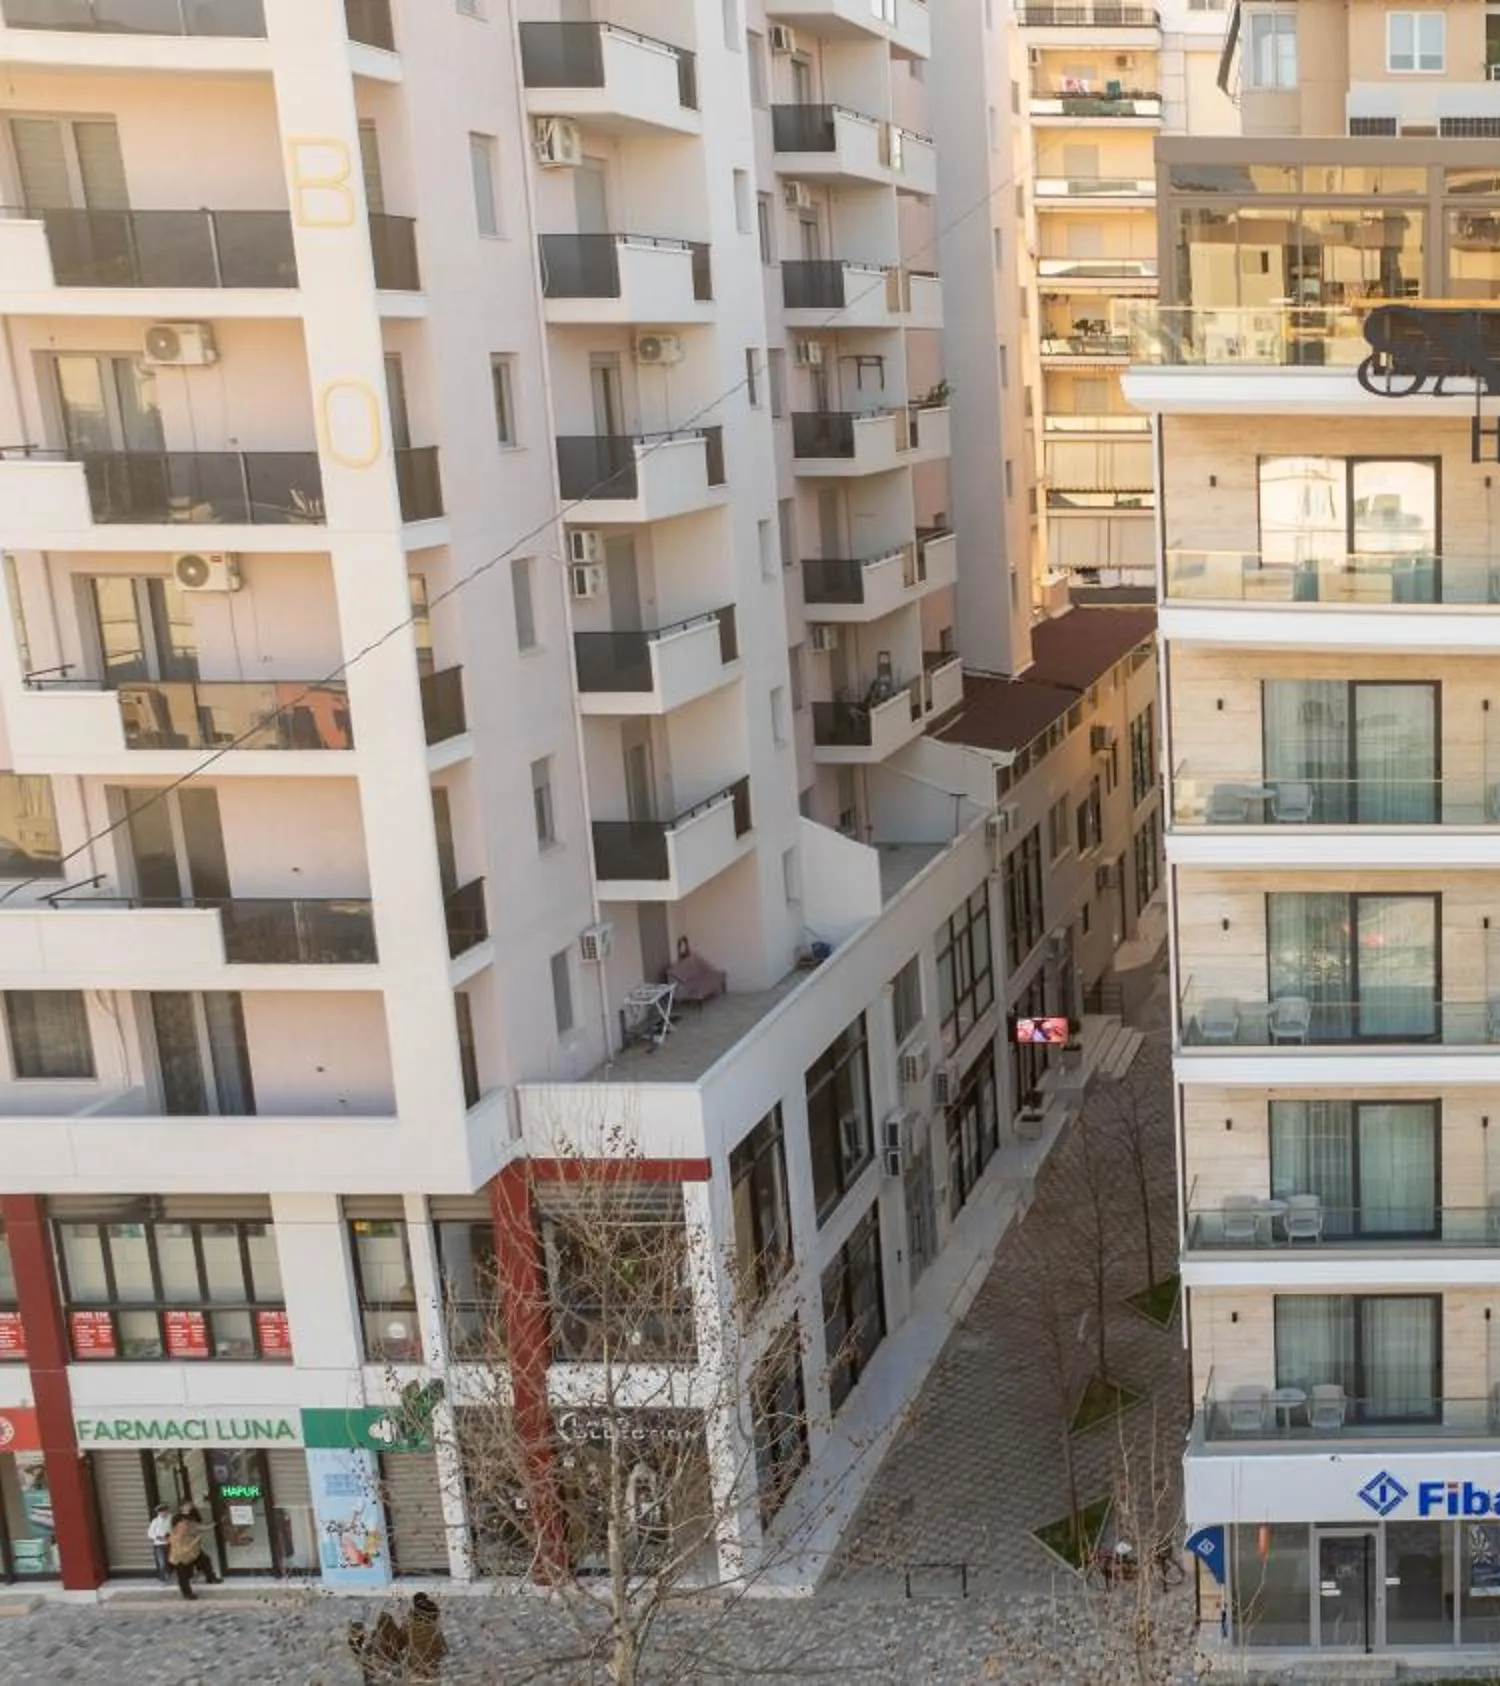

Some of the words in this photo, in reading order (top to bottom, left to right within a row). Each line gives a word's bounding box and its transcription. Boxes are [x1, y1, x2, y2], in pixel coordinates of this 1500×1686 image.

[78, 1419, 208, 1441] FARMACI
[216, 1419, 295, 1440] LUNA
[222, 1485, 259, 1497] HAPUR
